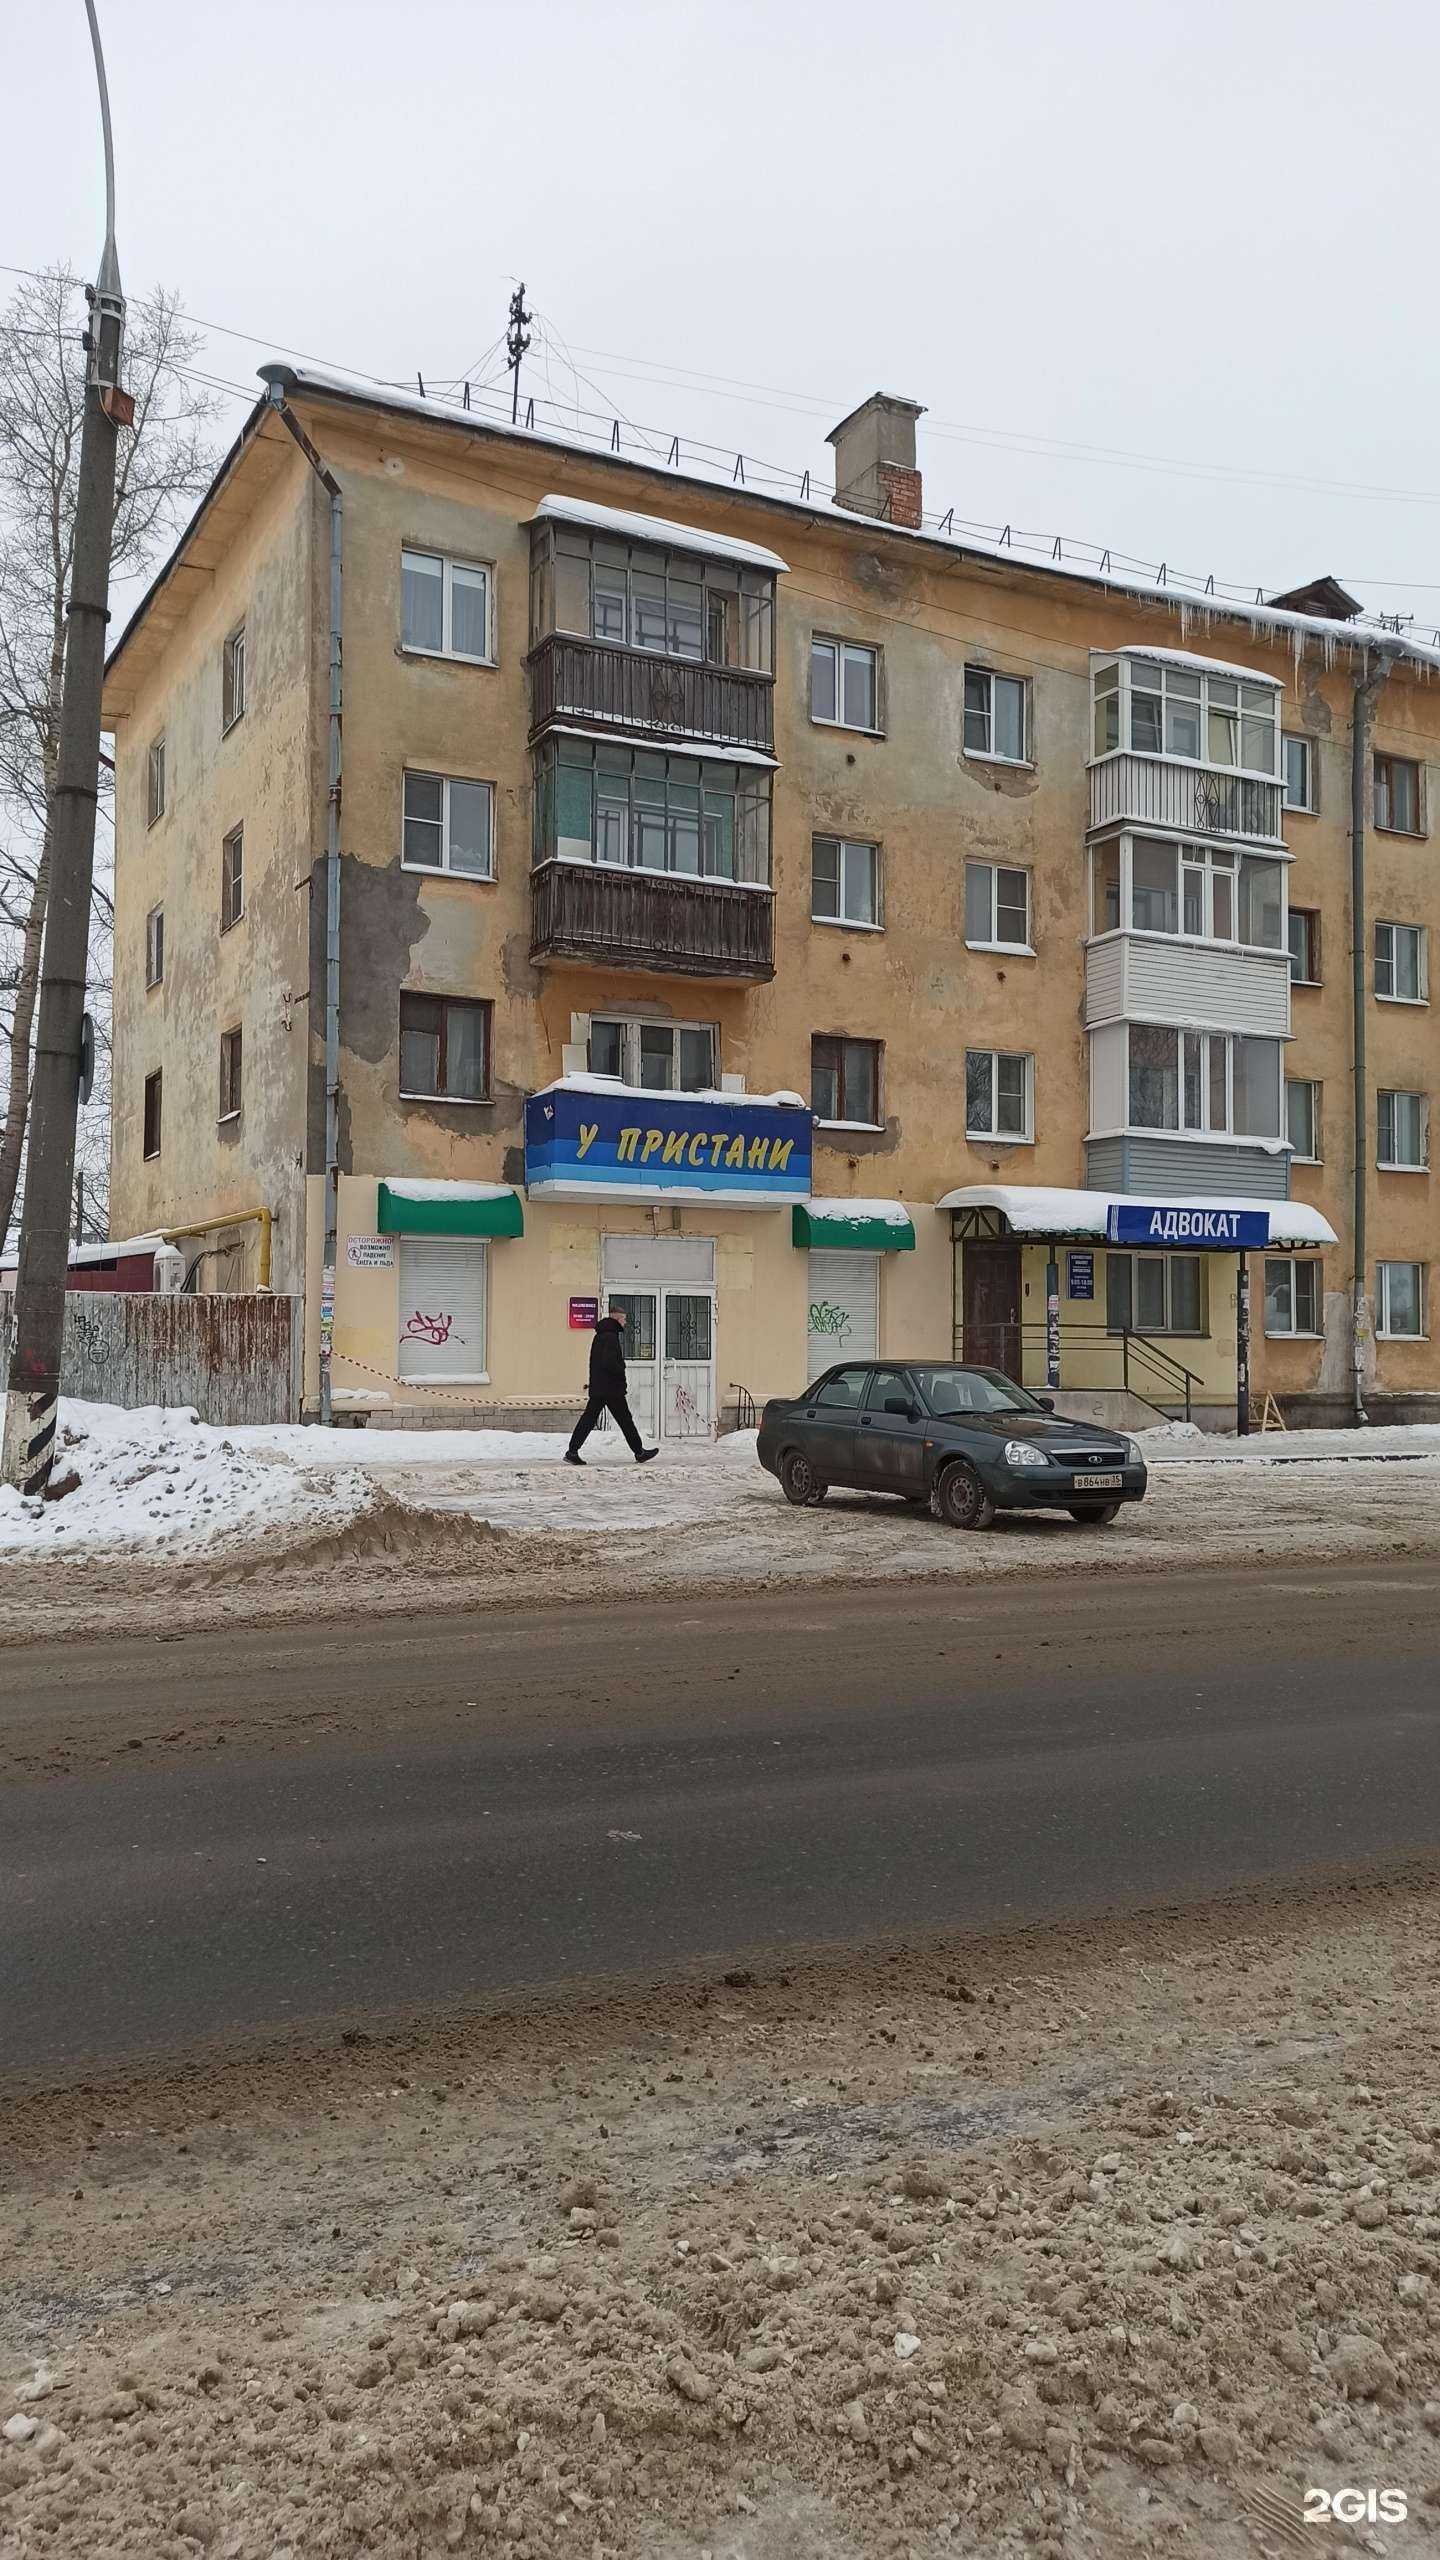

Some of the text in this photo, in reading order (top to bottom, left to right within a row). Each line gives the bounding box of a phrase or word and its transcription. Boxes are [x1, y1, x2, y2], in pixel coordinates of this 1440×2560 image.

[576, 1124, 795, 1171] У ПРИСТАНИ
[1149, 1210, 1241, 1240] АДВОКАТ
